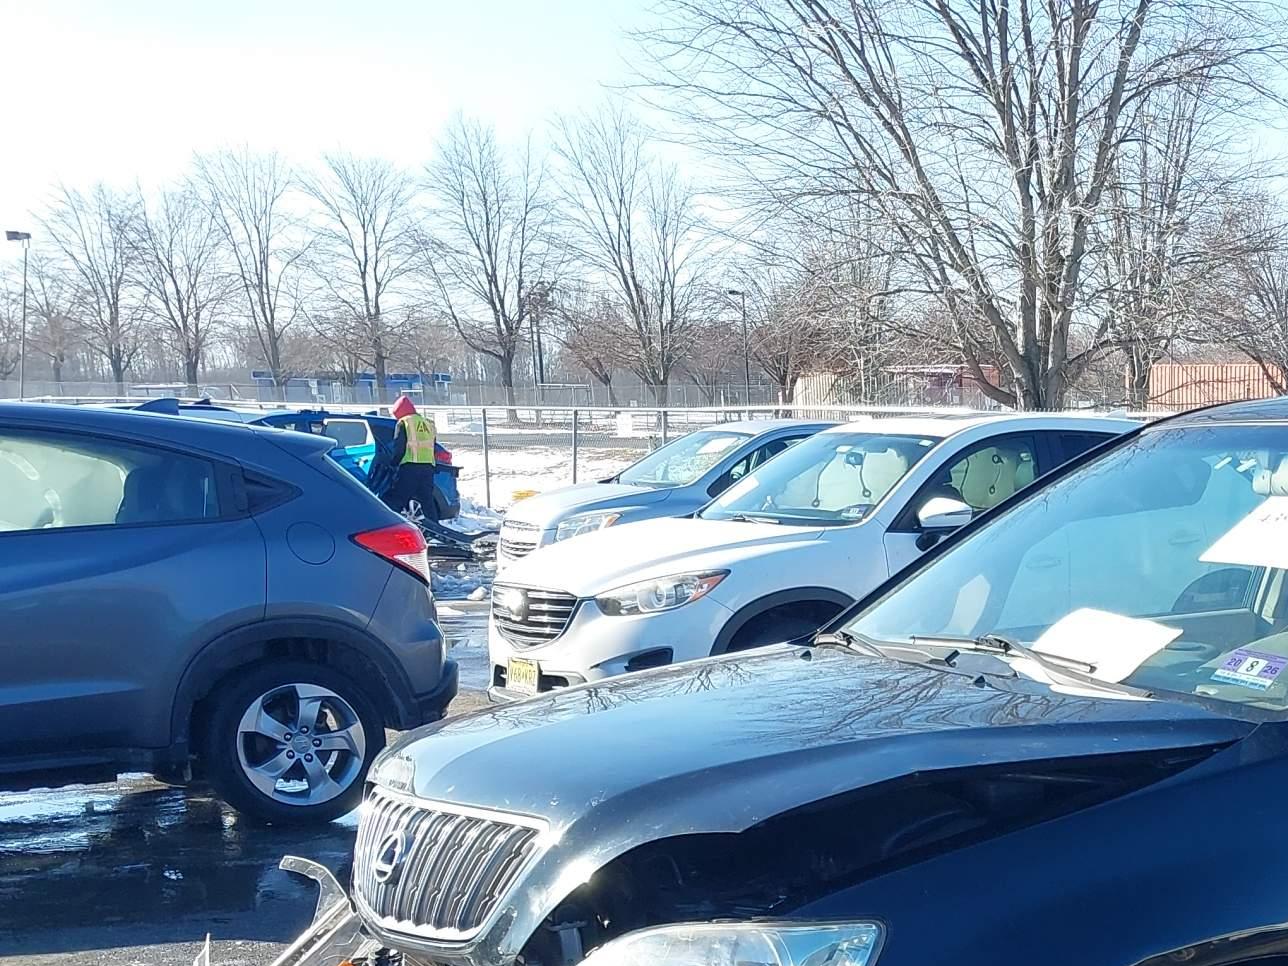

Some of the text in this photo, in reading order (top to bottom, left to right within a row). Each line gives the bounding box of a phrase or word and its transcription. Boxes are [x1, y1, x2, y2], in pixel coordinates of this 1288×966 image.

[1227, 658, 1280, 675] 20 8 26
